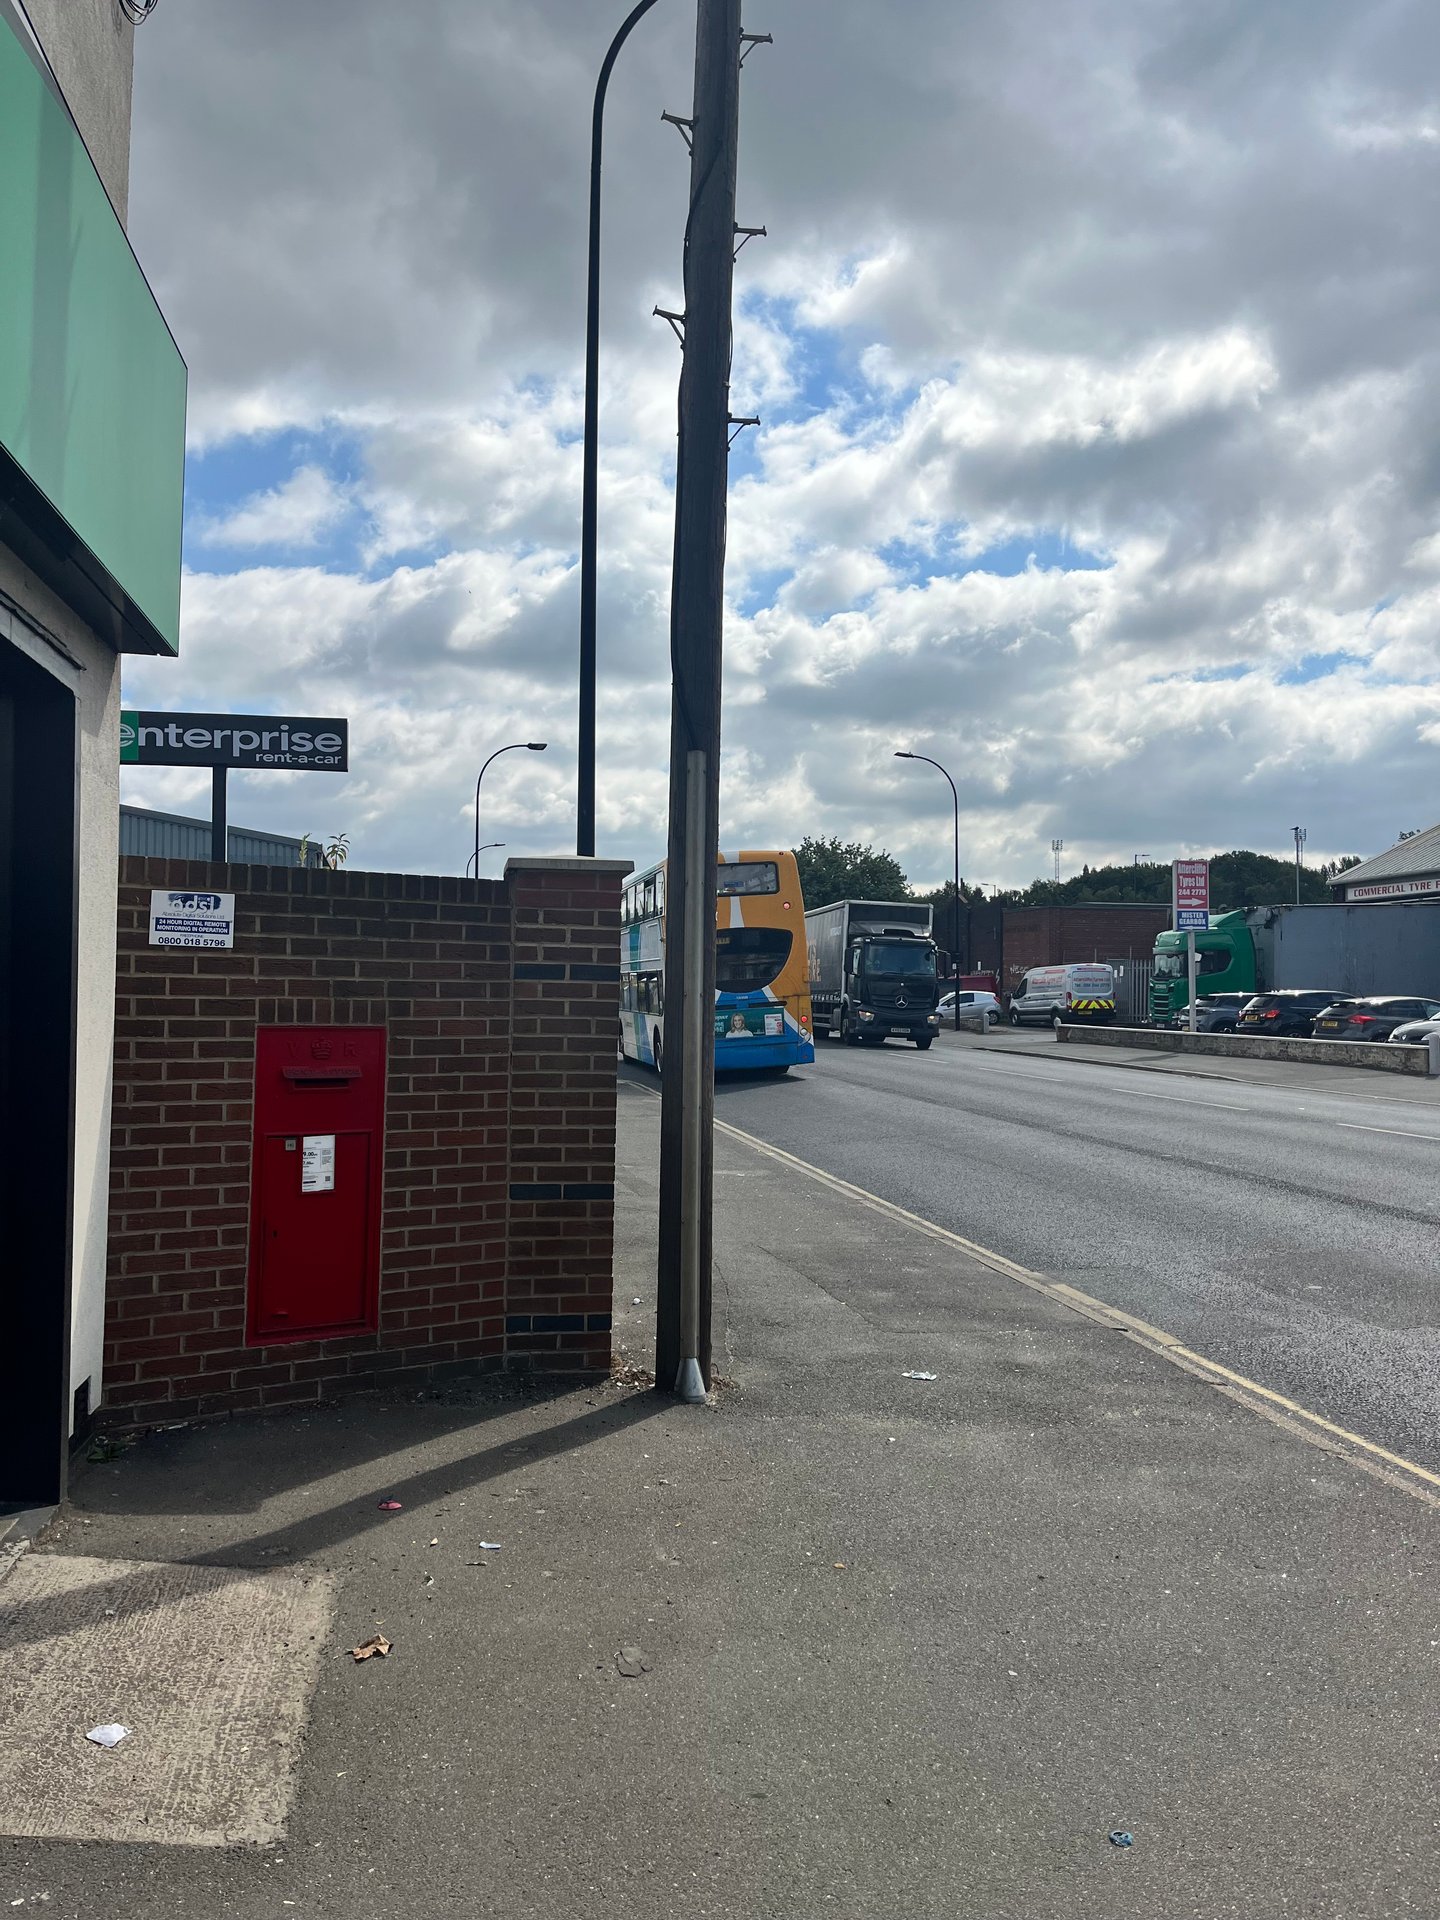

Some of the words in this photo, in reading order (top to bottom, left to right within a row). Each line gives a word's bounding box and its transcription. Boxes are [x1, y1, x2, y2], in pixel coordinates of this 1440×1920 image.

[255, 752, 342, 764] rent-a-car
[1178, 863, 1206, 874] Attercliffe
[1179, 875, 1195, 887] Tyres
[1196, 875, 1205, 886] Ltd
[1353, 885, 1405, 897] COMMERCIAL
[1409, 881, 1432, 891] TYRE
[158, 937, 181, 945] 0800
[184, 938, 201, 946] 018
[203, 939, 226, 947] 5796
